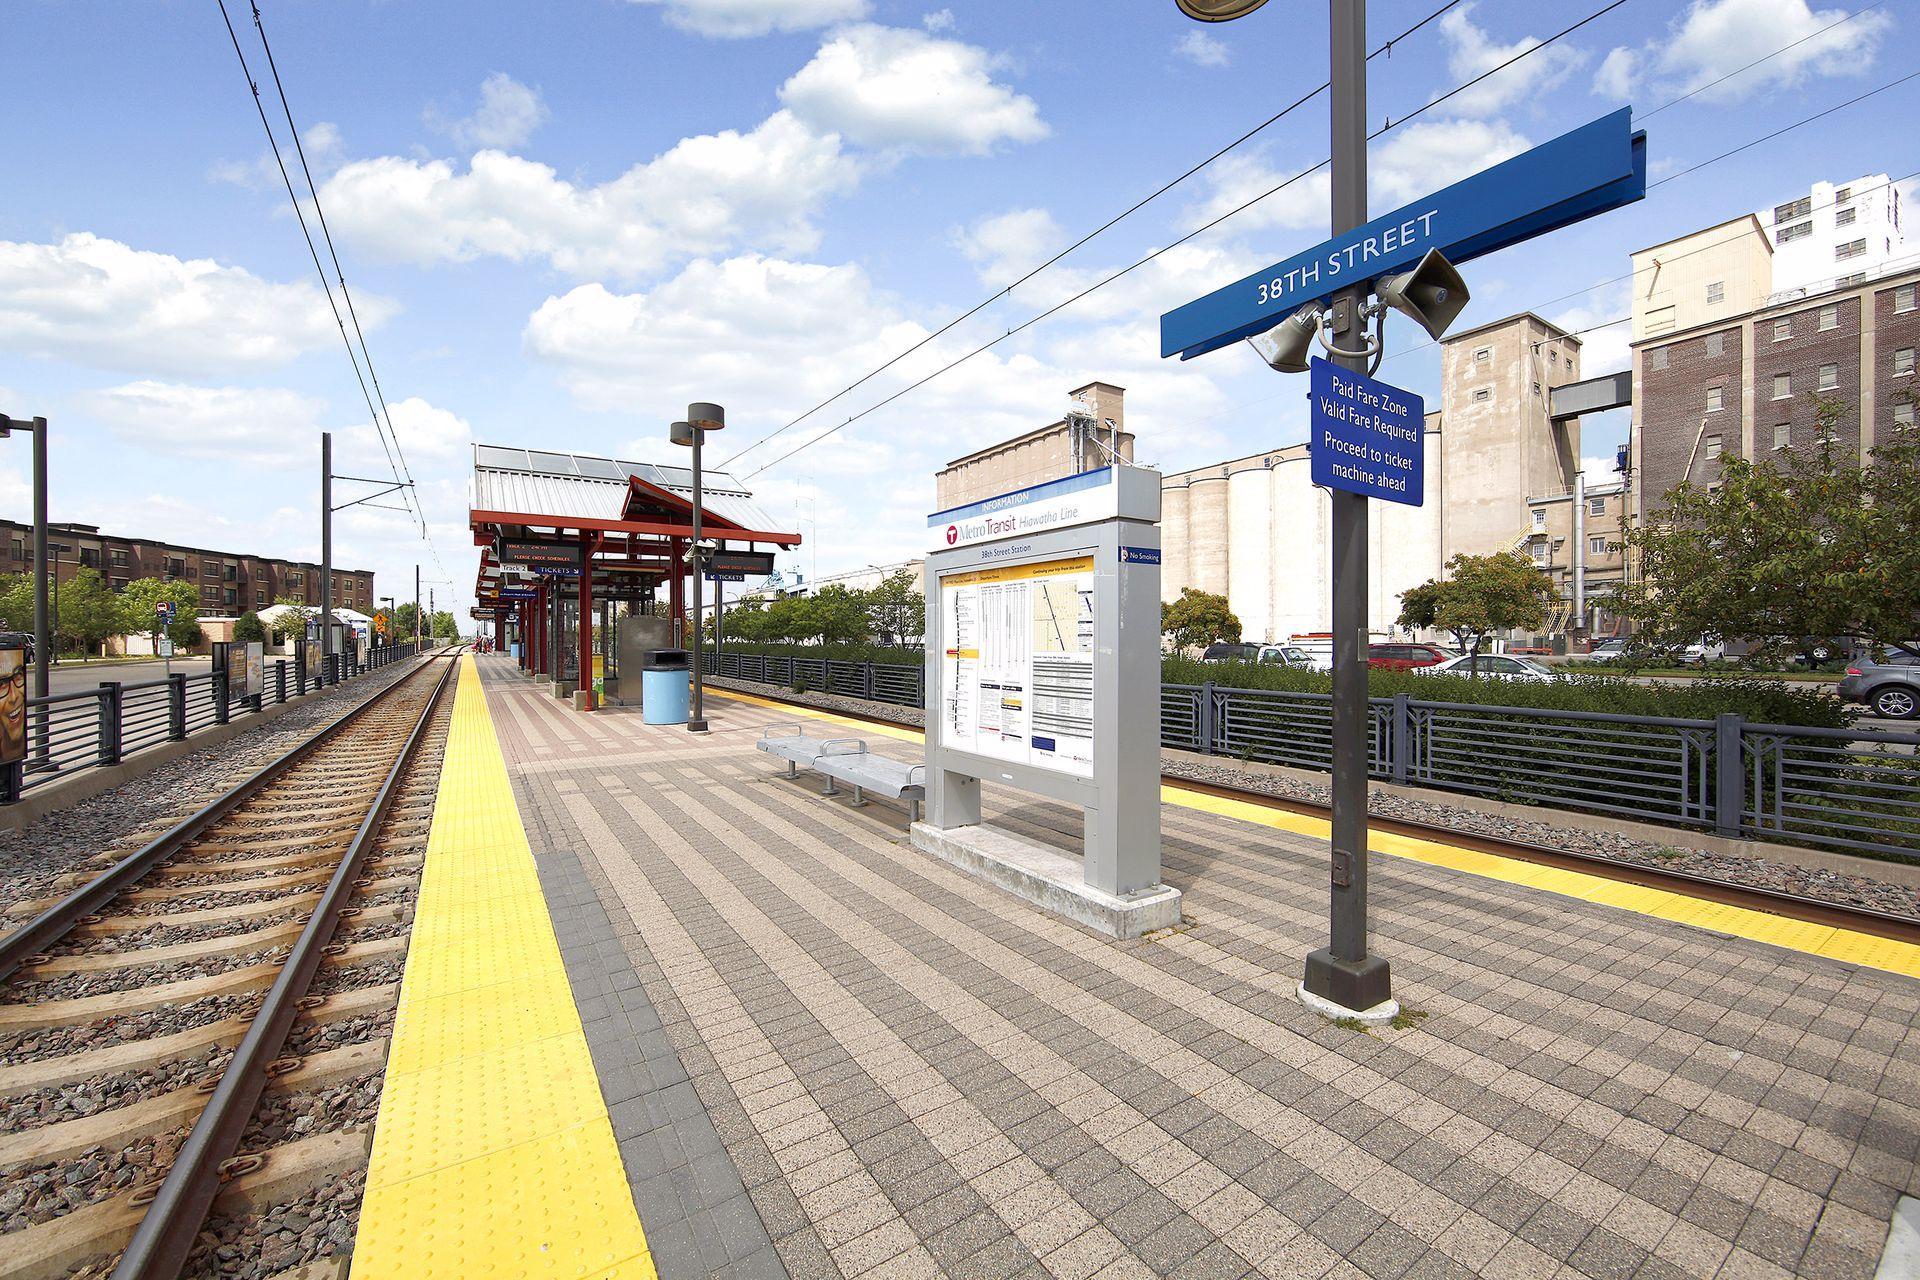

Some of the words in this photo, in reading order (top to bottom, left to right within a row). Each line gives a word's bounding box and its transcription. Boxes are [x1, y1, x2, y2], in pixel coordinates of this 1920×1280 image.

[1257, 260, 1320, 305] 38TH
[1328, 209, 1438, 276] STREET
[1332, 375, 1354, 399] Paid
[1357, 385, 1379, 407] Fare
[1381, 394, 1408, 417] Zone
[1320, 396, 1346, 421] Valid
[1349, 406, 1371, 429] Fare
[1373, 415, 1417, 443] Required
[1325, 430, 1367, 459] Proceed
[1370, 448, 1382, 462] to
[1385, 450, 1413, 471] ticket
[1332, 463, 1374, 485] machine
[1377, 471, 1406, 492] ahead
[981, 492, 1030, 512] INFORMATION
[1018, 509, 1058, 528] Hiawatha
[1060, 507, 1078, 520] Line
[981, 550, 993, 560] 38th
[993, 547, 1010, 557] Street
[1011, 544, 1032, 555] Station
[1129, 552, 1139, 560] No
[1139, 552, 1159, 563] Smoking
[541, 567, 570, 575] TICKETS
